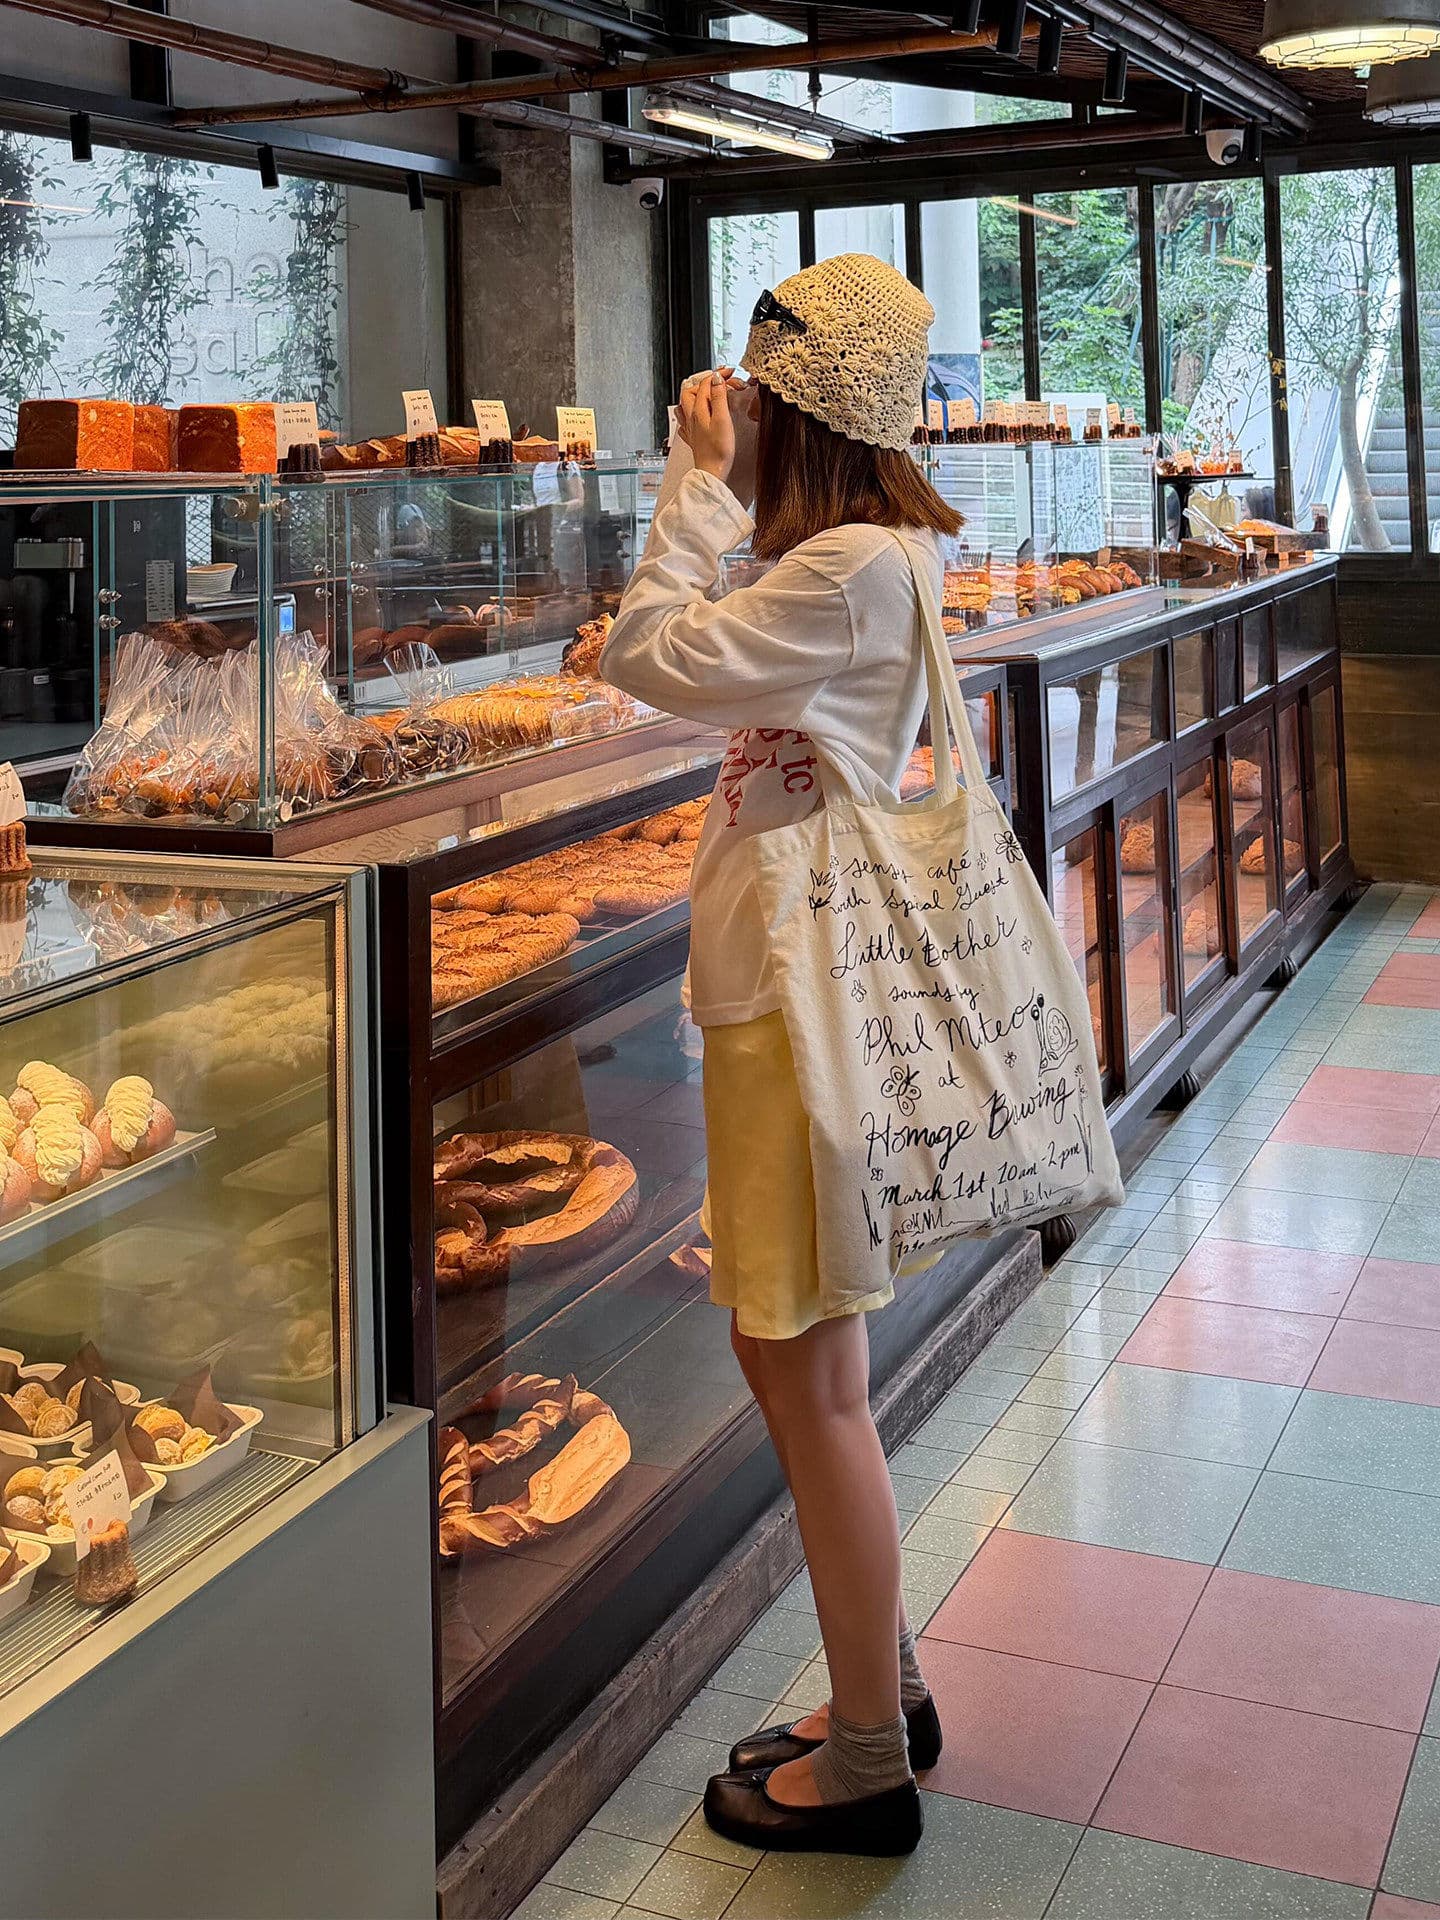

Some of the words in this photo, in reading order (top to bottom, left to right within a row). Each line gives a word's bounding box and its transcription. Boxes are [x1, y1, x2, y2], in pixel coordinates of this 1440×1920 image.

[927, 849, 972, 885] café
[829, 886, 871, 916] with
[952, 867, 1010, 911] Guest
[830, 920, 914, 979] Little
[888, 981, 956, 1003] sounds
[855, 1012, 934, 1066] Phil
[938, 1061, 966, 1090] at
[859, 1111, 980, 1171] Homage
[878, 1176, 953, 1210] March
[952, 1170, 986, 1200] 1st
